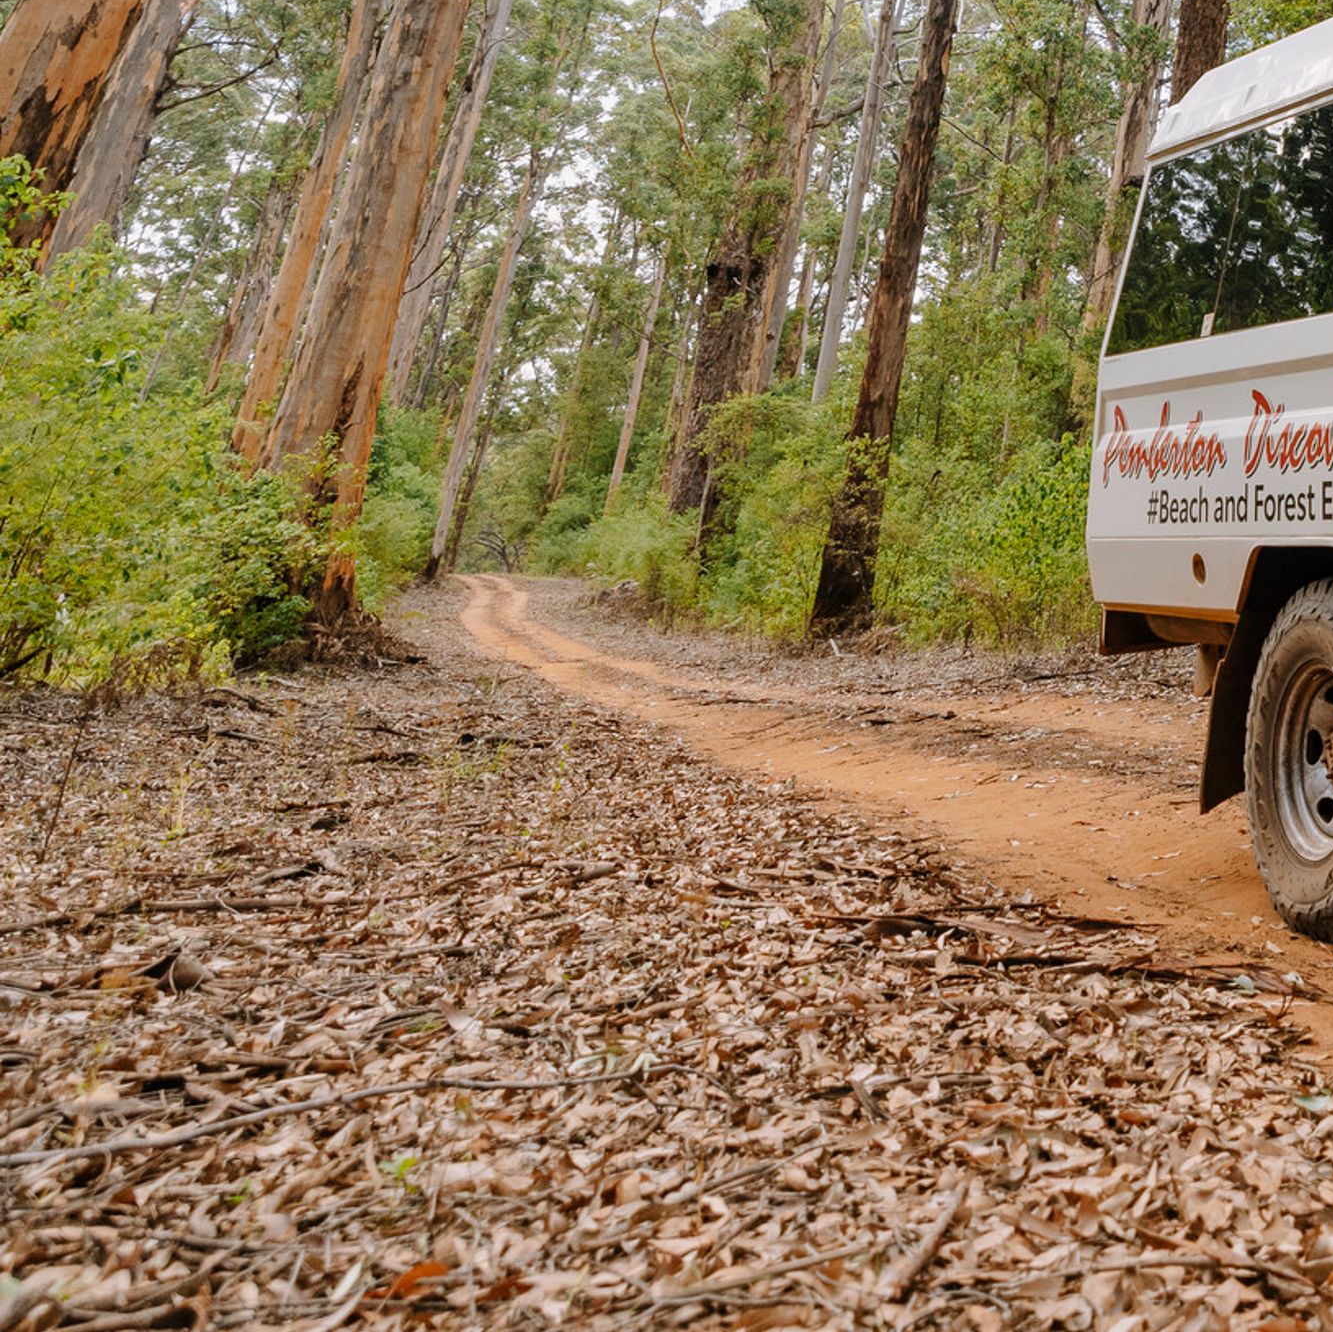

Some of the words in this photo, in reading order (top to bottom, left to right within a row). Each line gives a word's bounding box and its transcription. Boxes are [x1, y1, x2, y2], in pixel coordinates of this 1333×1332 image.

[1102, 400, 1228, 489] Pemberton
[1147, 486, 1209, 524] #Beach
[1213, 483, 1249, 524] and
[1254, 484, 1316, 522] Forest
